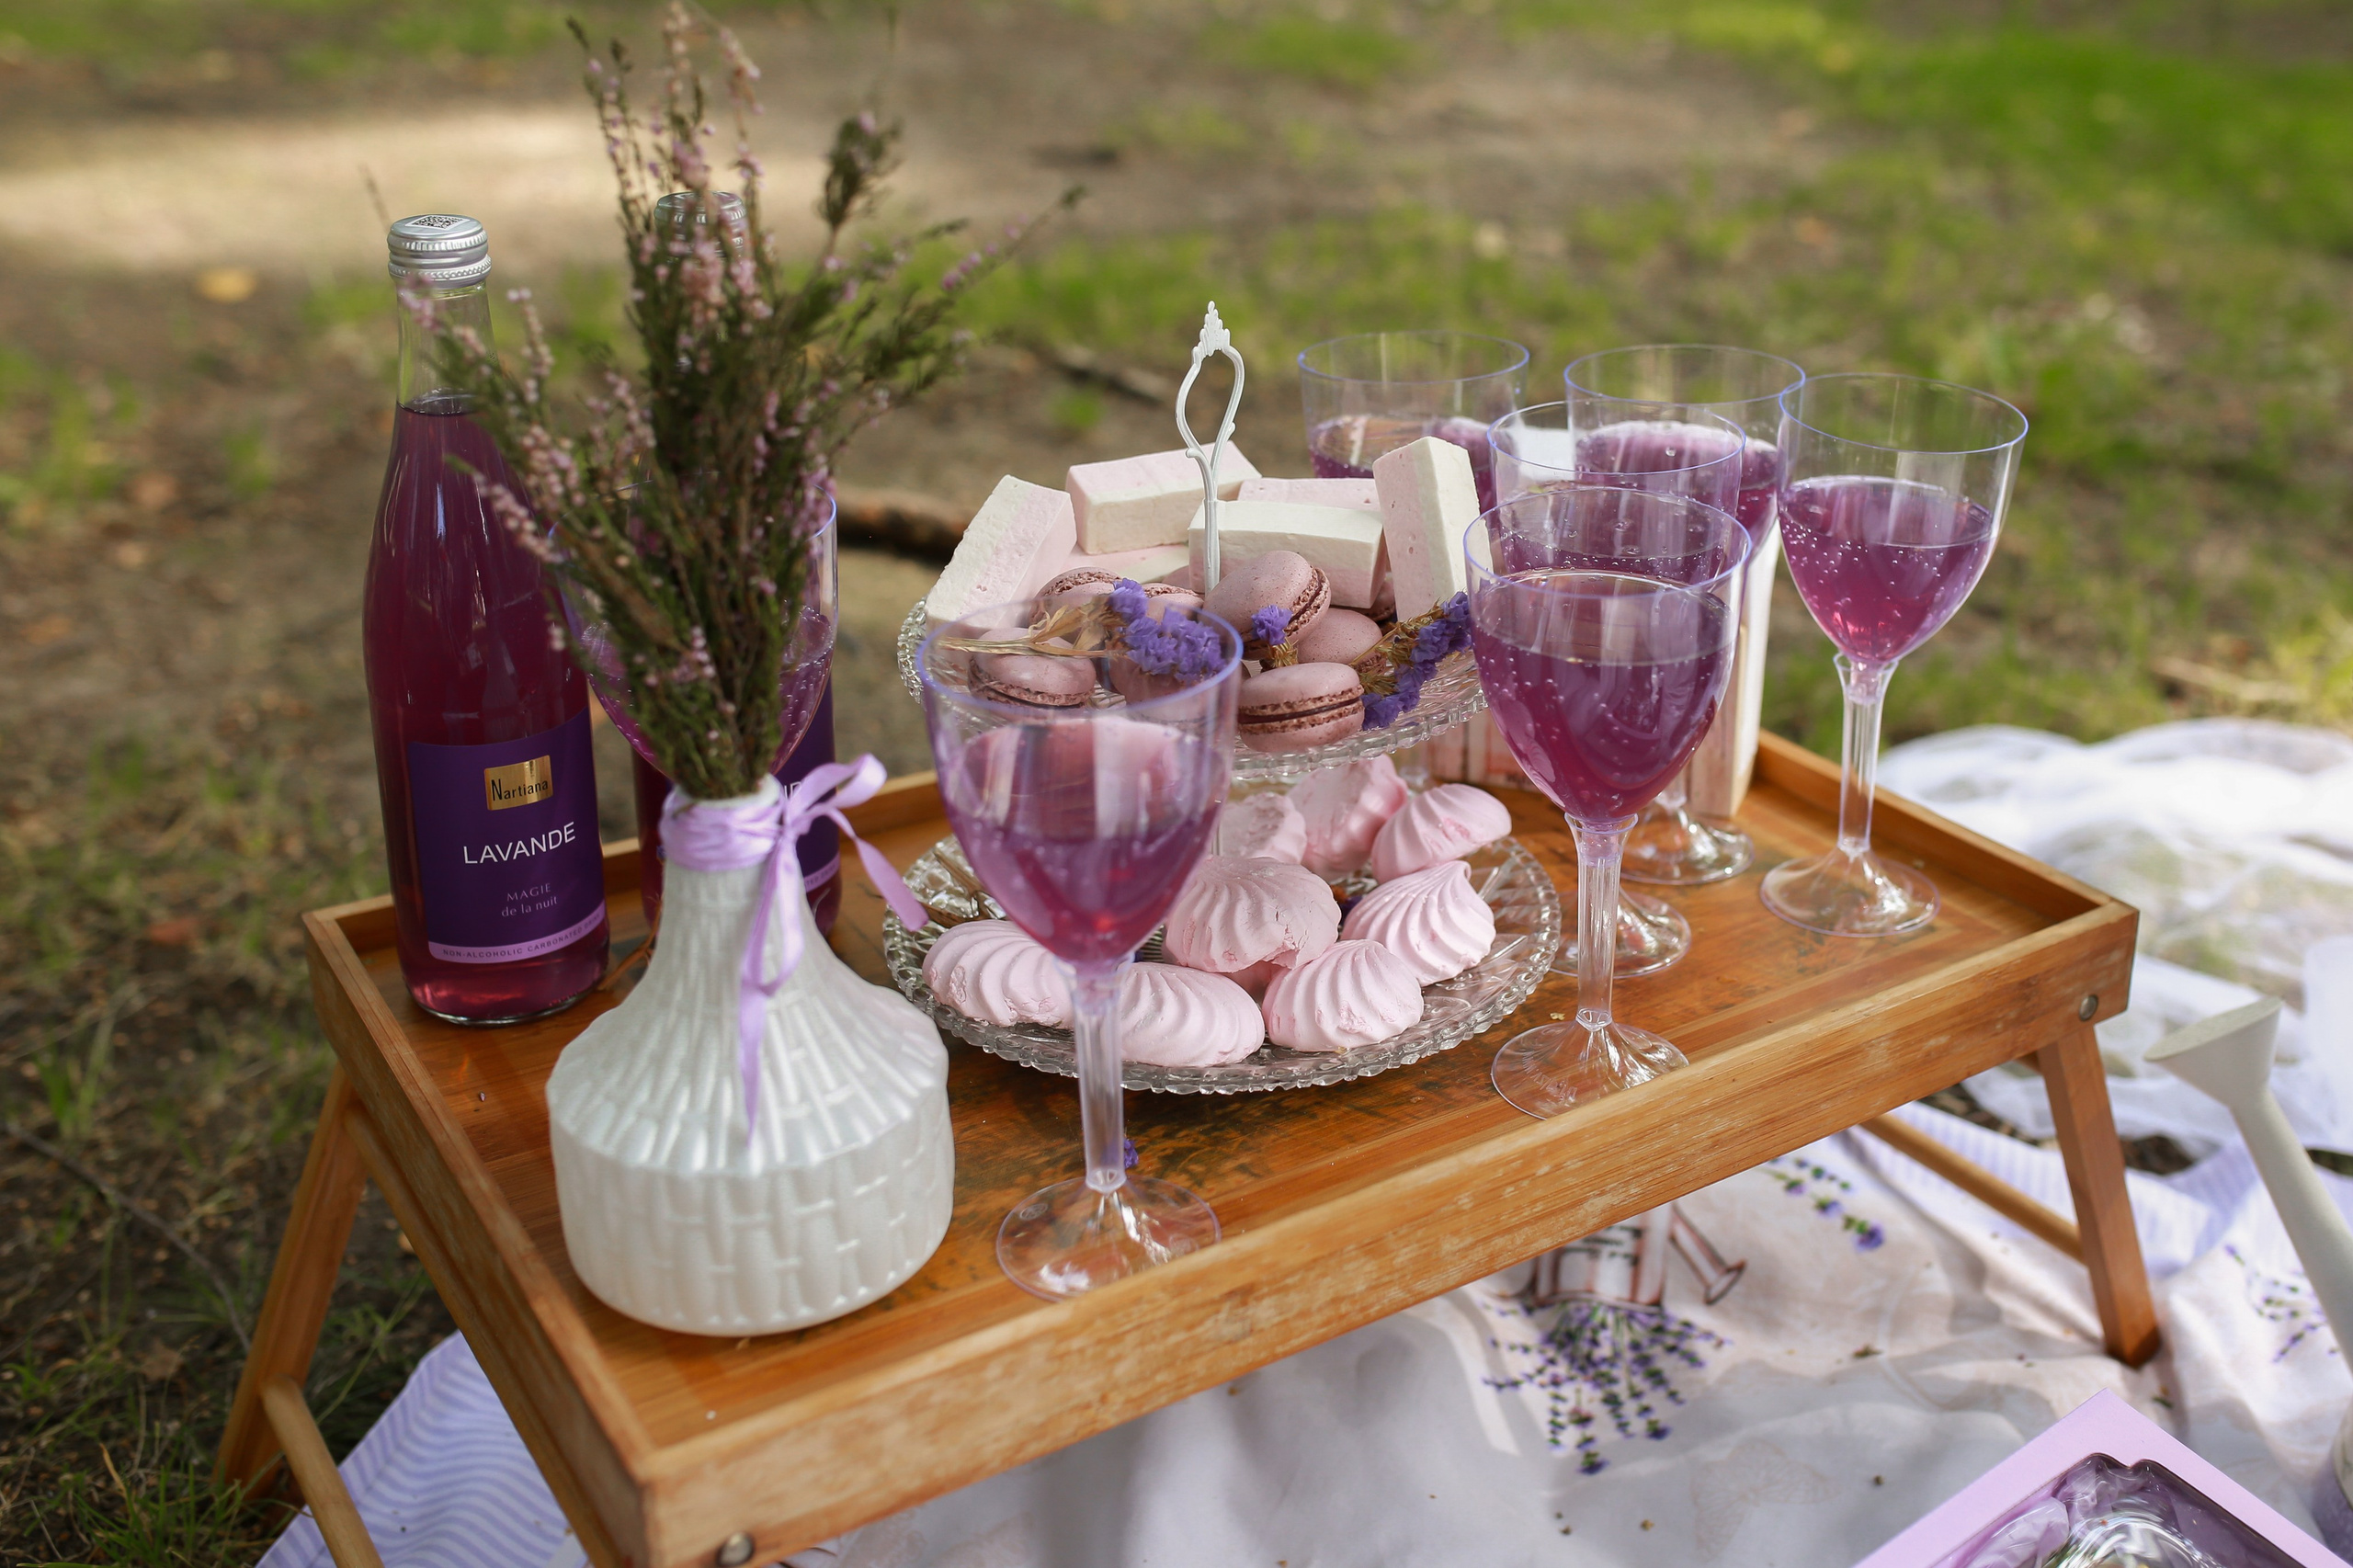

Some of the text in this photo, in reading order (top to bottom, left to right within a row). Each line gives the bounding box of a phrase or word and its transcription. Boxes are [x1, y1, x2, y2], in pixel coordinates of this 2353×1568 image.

[491, 778, 549, 801] Nartiana
[463, 822, 576, 864] LAVANDE
[506, 882, 552, 902] MAGIE
[501, 896, 558, 918] de la nuit
[443, 948, 523, 959] NON-ALCOHOLIC
[527, 926, 583, 952] CARBONATED
